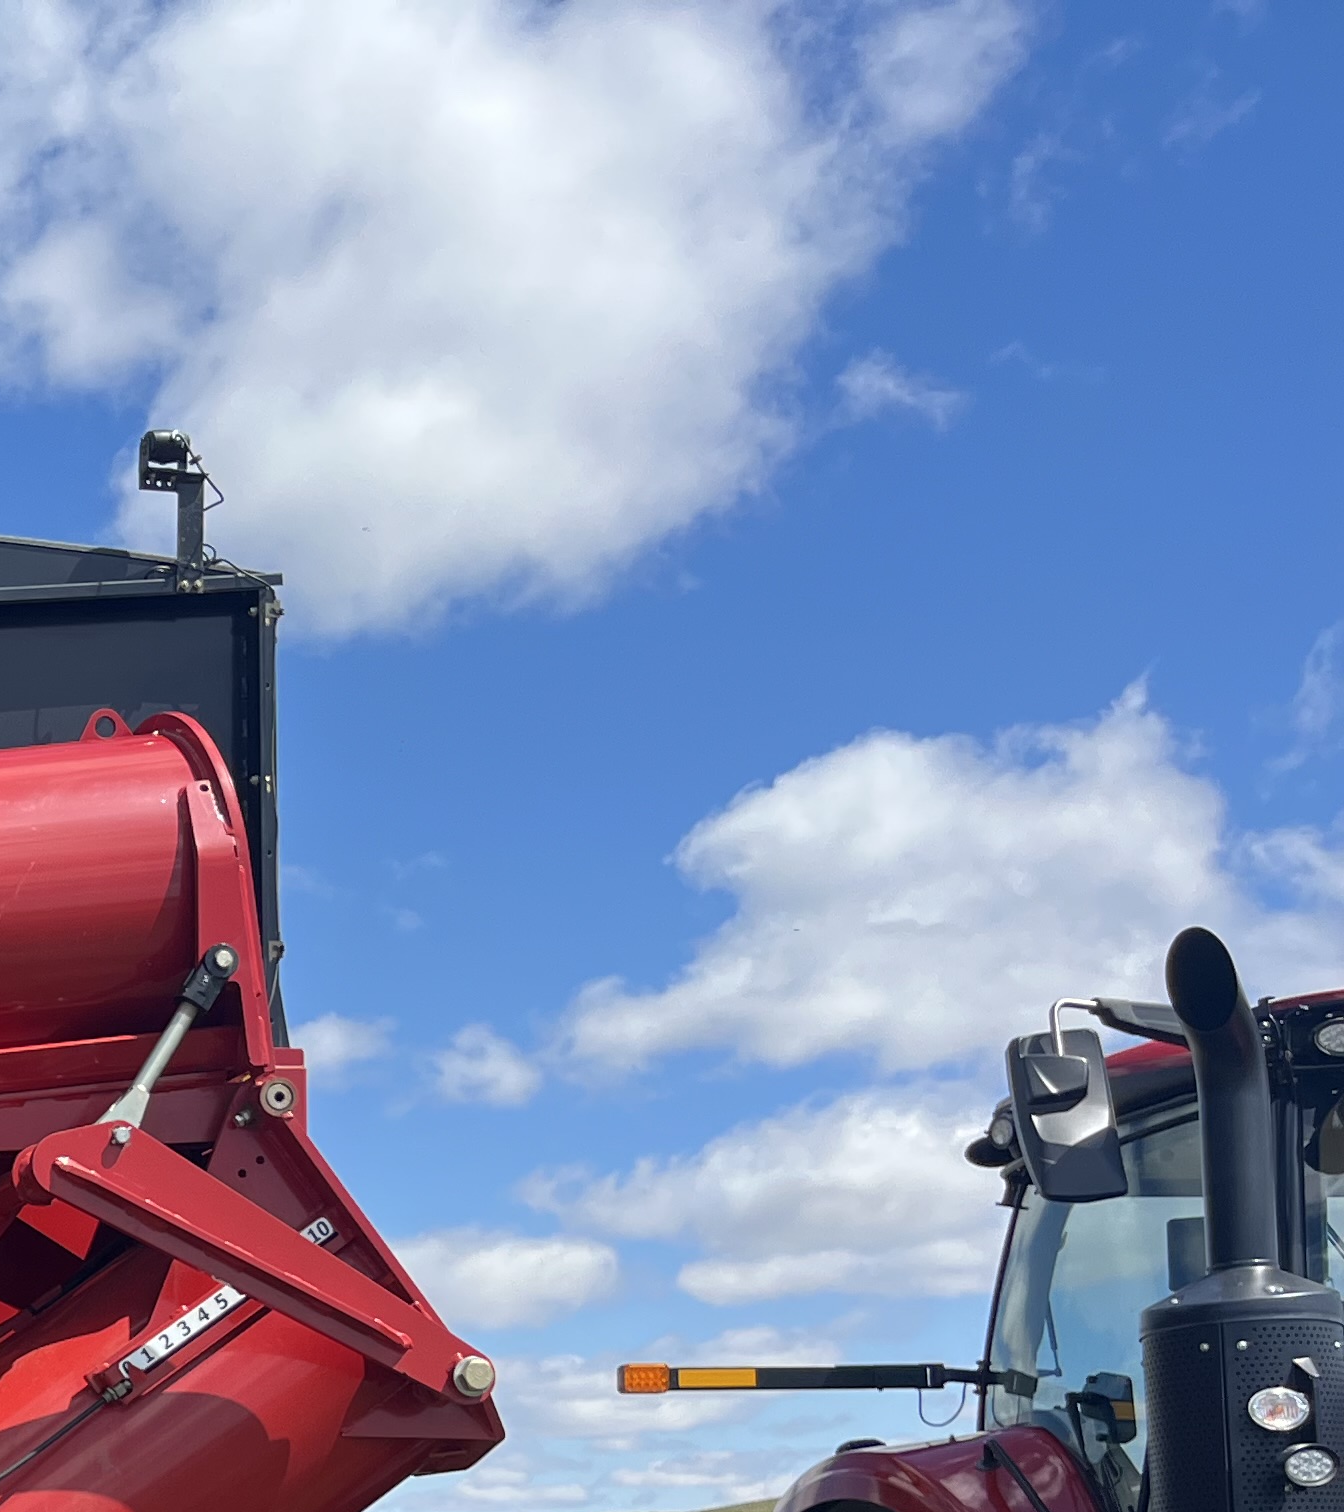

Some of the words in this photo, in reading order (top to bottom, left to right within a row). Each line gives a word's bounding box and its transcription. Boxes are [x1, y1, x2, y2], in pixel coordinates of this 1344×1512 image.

[307, 1221, 330, 1243] 10
[141, 1348, 154, 1363] 1
[158, 1334, 174, 1349] 2
[177, 1321, 191, 1336] 3
[198, 1307, 209, 1321] 4
[214, 1293, 228, 1310] 5
